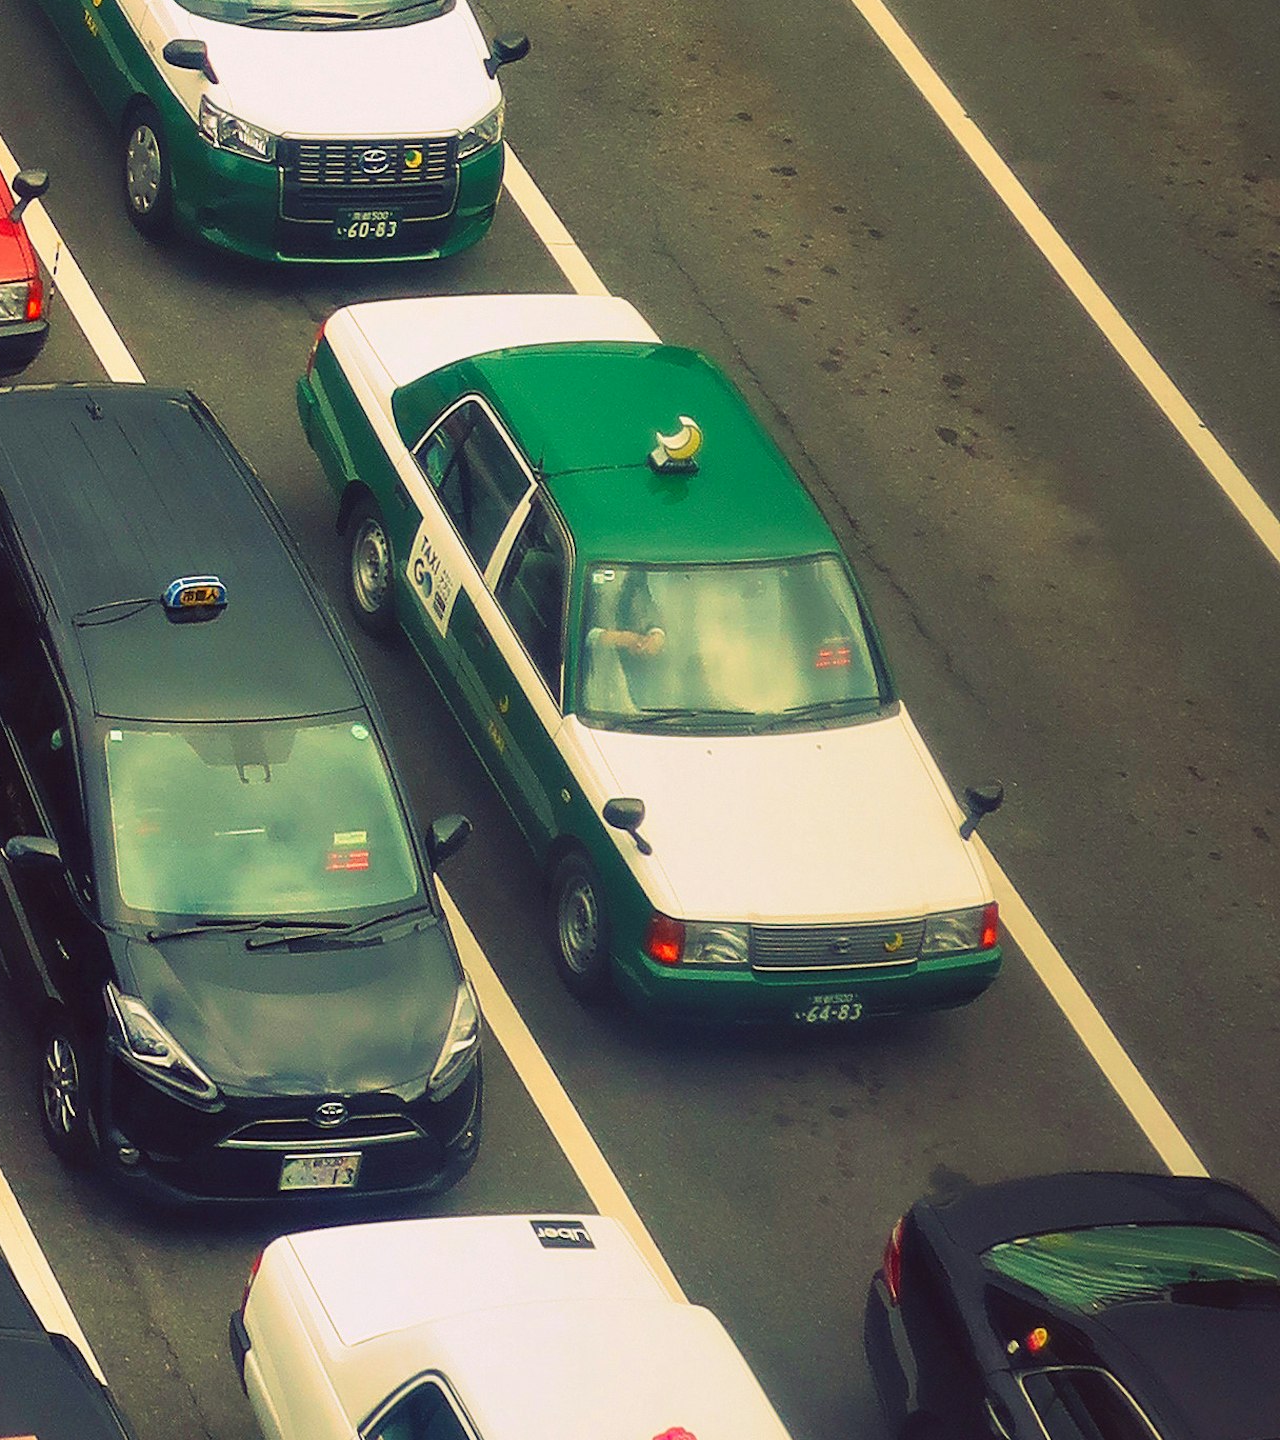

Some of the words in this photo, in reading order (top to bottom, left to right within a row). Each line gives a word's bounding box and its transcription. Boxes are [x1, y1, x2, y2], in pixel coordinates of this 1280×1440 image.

[347, 221, 397, 238] 60-83
[421, 534, 441, 576] TAXI
[806, 1003, 863, 1022] 64-83
[538, 1227, 591, 1242] Uber
